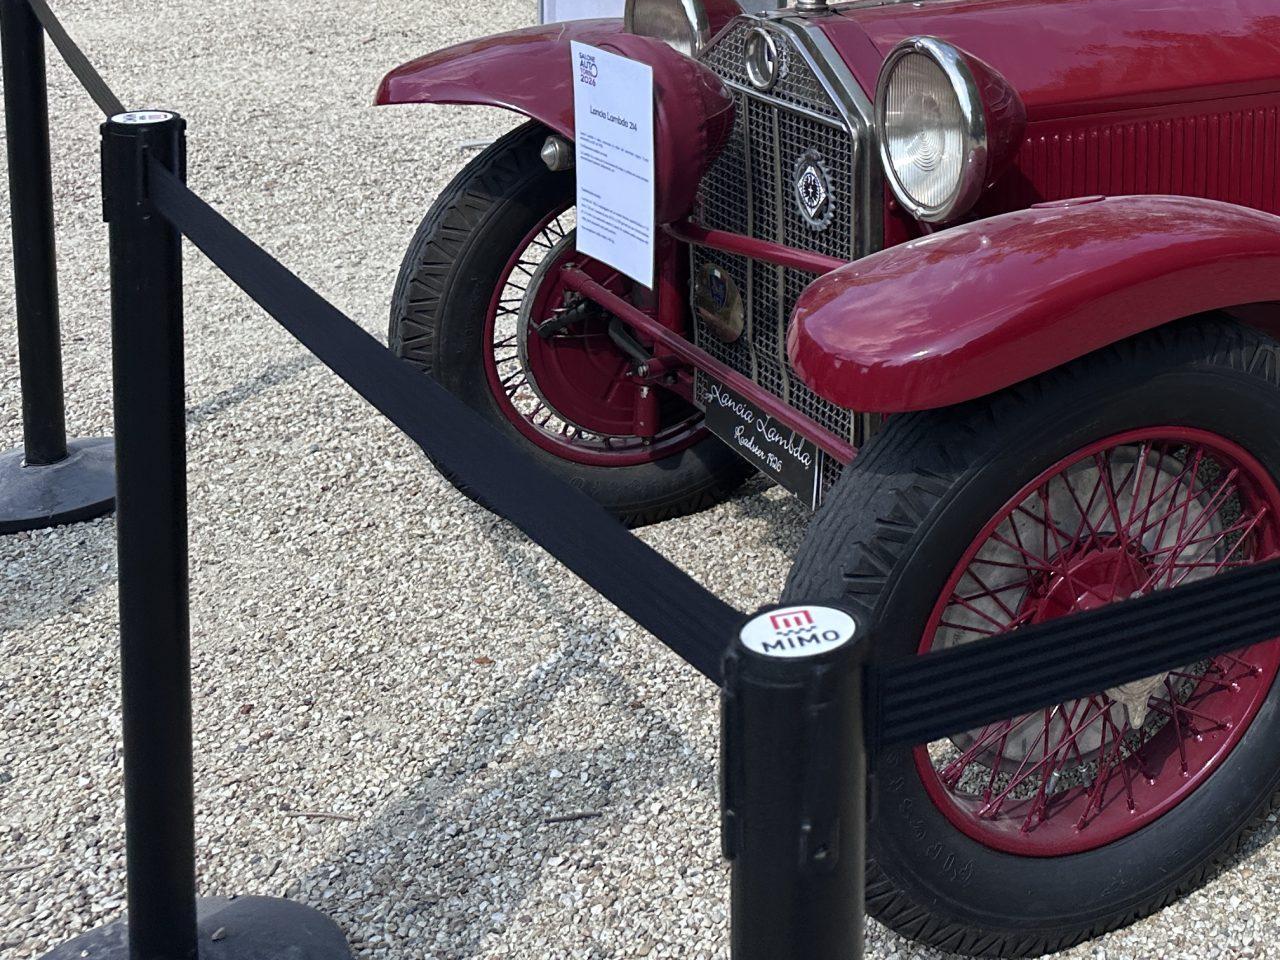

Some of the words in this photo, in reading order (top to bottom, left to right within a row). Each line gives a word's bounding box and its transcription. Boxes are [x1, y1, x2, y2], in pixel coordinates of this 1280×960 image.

[590, 104, 607, 120] Lancia
[607, 111, 629, 128] Lambda
[705, 384, 754, 424] Lancia
[756, 414, 812, 466] Lambda
[734, 425, 766, 460] Roadster
[761, 629, 841, 653] MIMO
